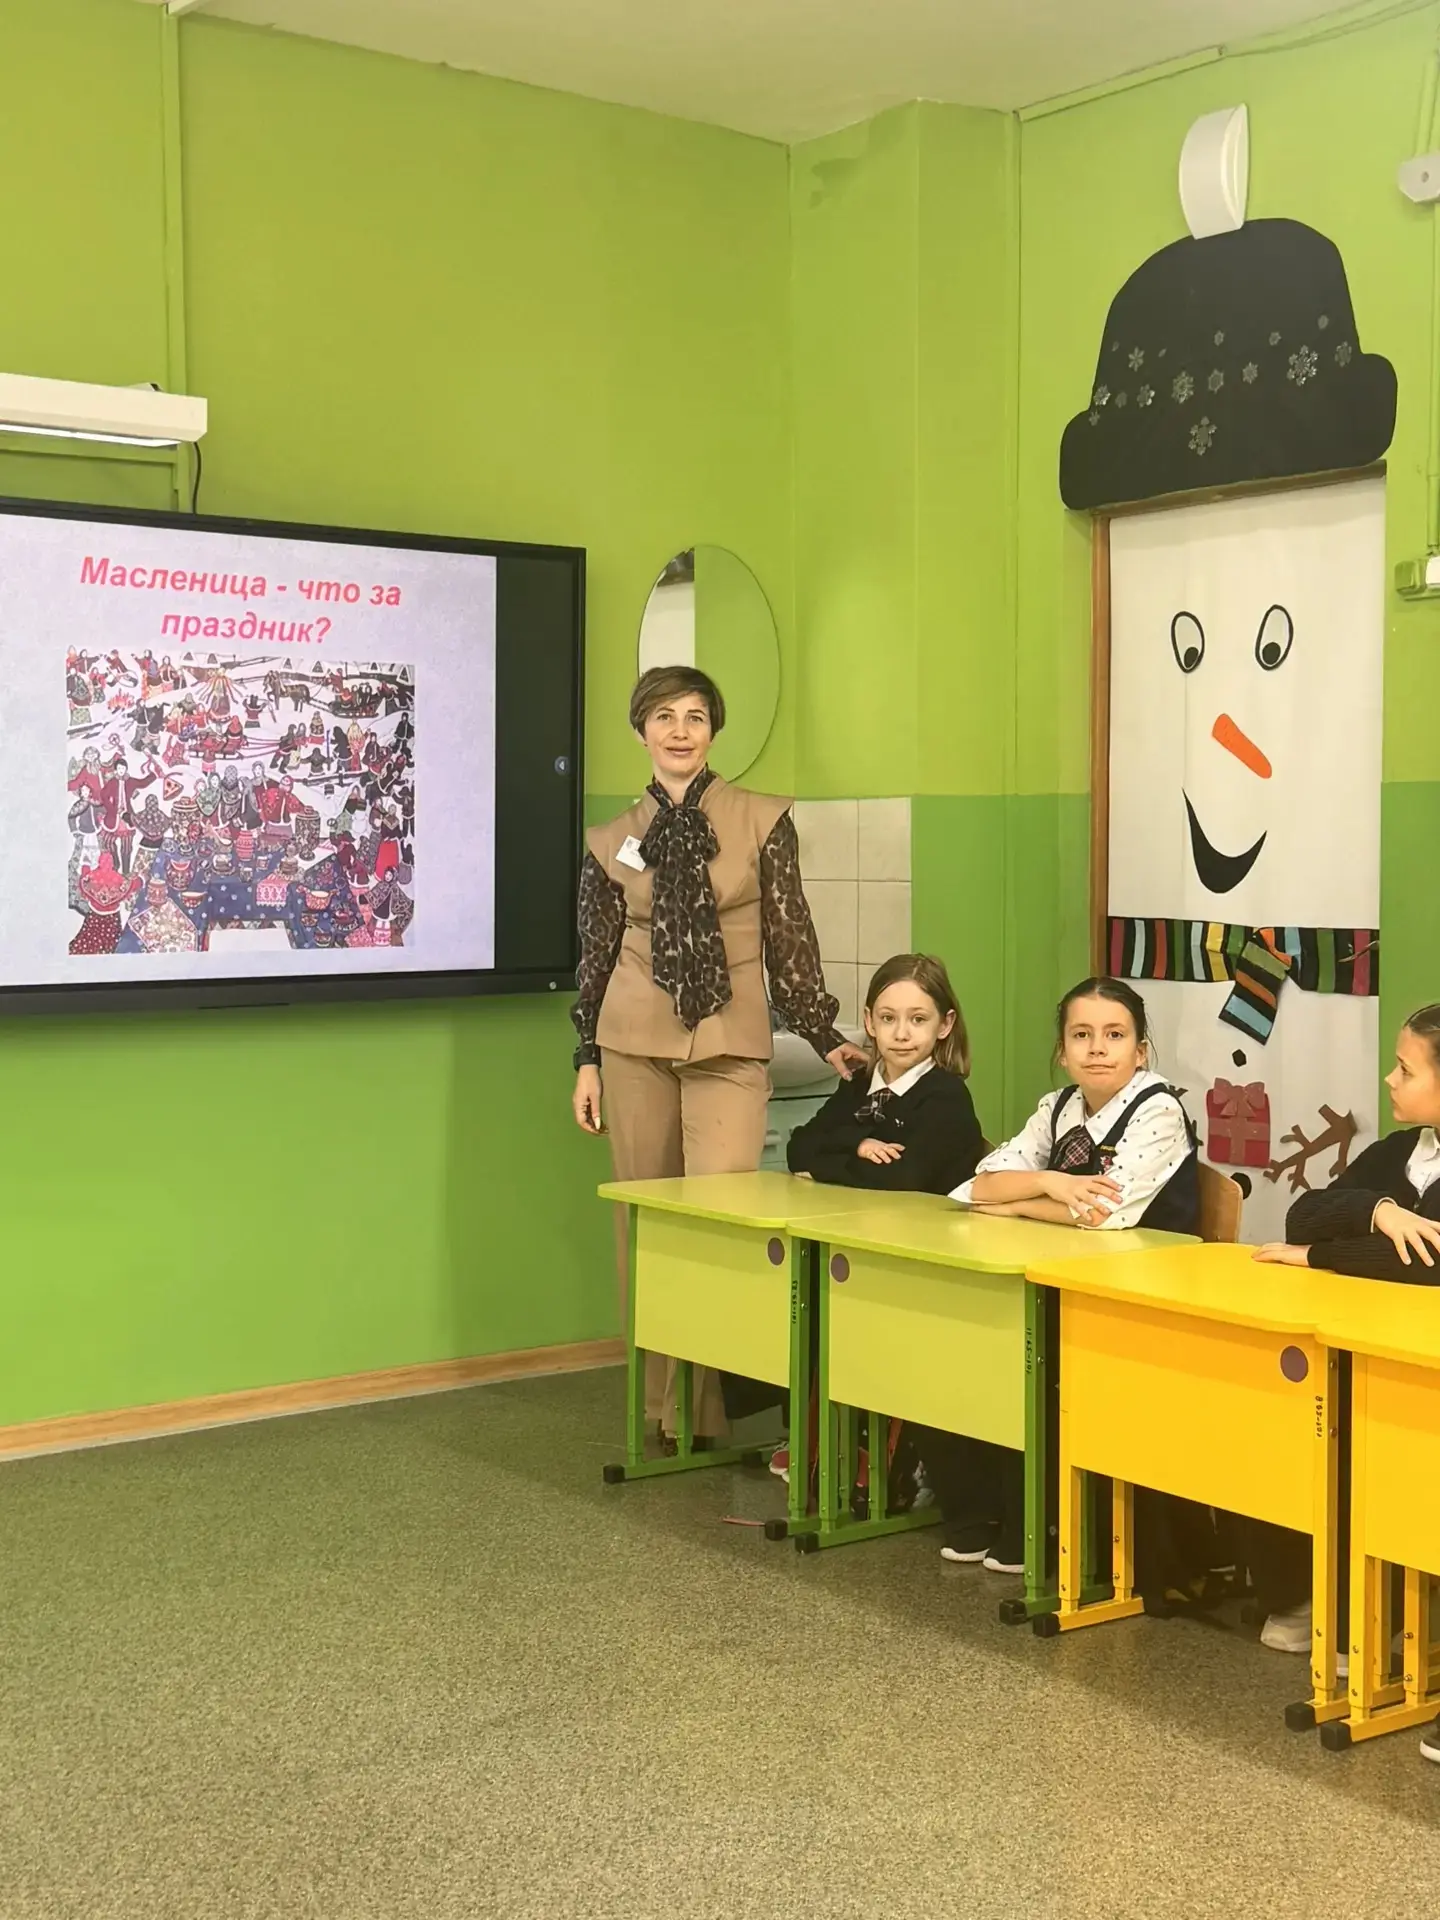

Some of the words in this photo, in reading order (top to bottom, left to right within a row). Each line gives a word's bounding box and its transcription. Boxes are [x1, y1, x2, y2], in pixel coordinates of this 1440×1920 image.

[80, 556, 267, 600] Масленица
[298, 579, 360, 604] что
[368, 584, 401, 606] за
[160, 611, 332, 644] праздник?
